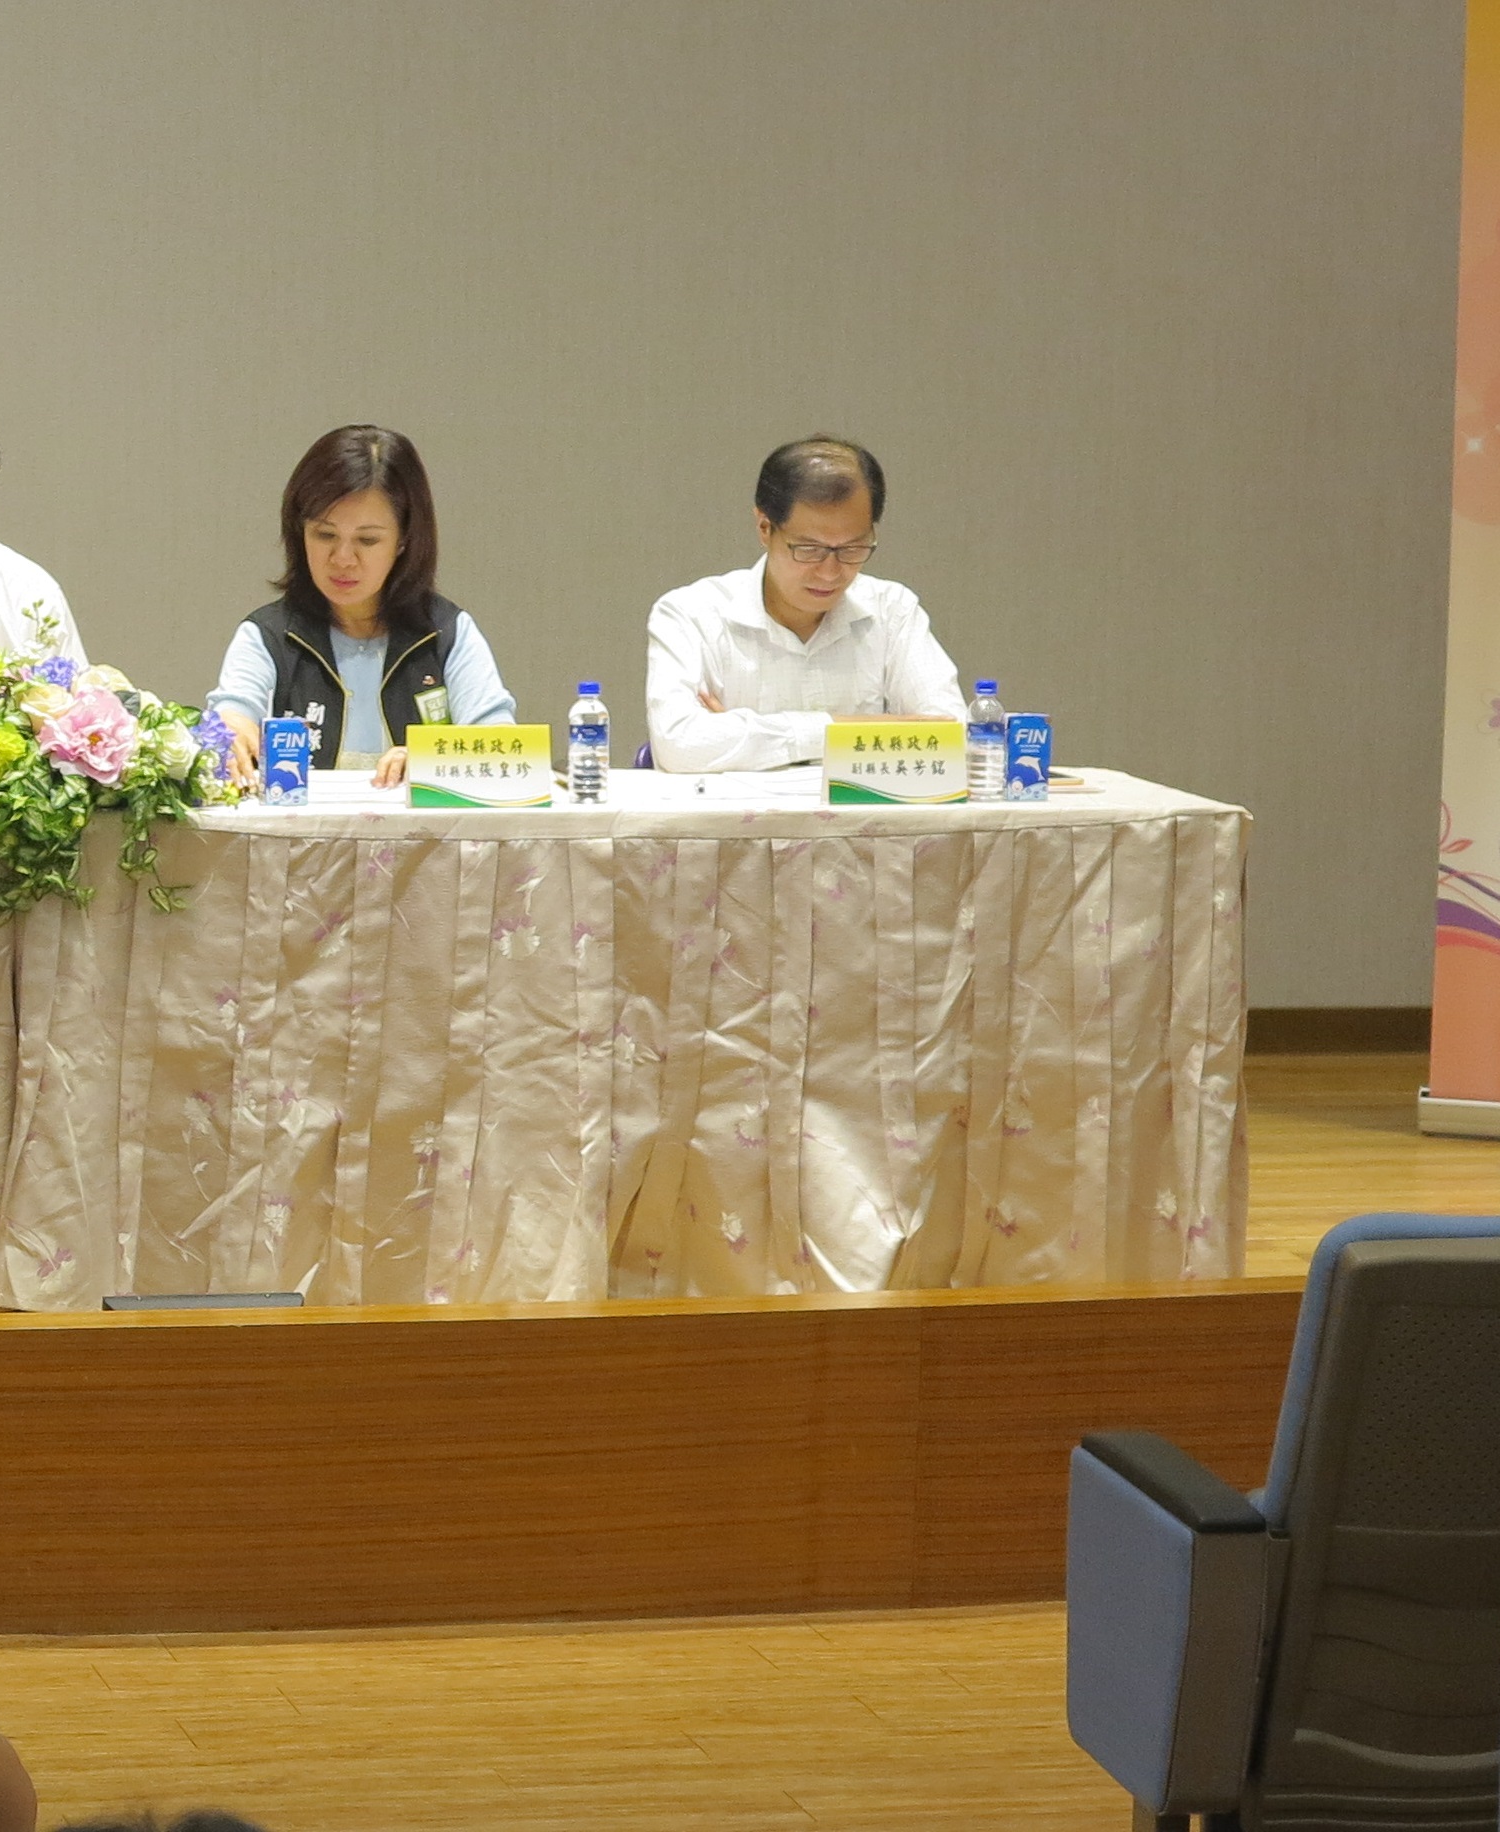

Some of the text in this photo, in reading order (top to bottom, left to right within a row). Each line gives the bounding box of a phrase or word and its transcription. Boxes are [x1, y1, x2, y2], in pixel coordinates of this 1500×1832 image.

[272, 732, 306, 749] FIN
[853, 735, 939, 752] 嘉義縣政府
[1015, 728, 1048, 744] FIN
[434, 738, 524, 755] 雲林縣政府
